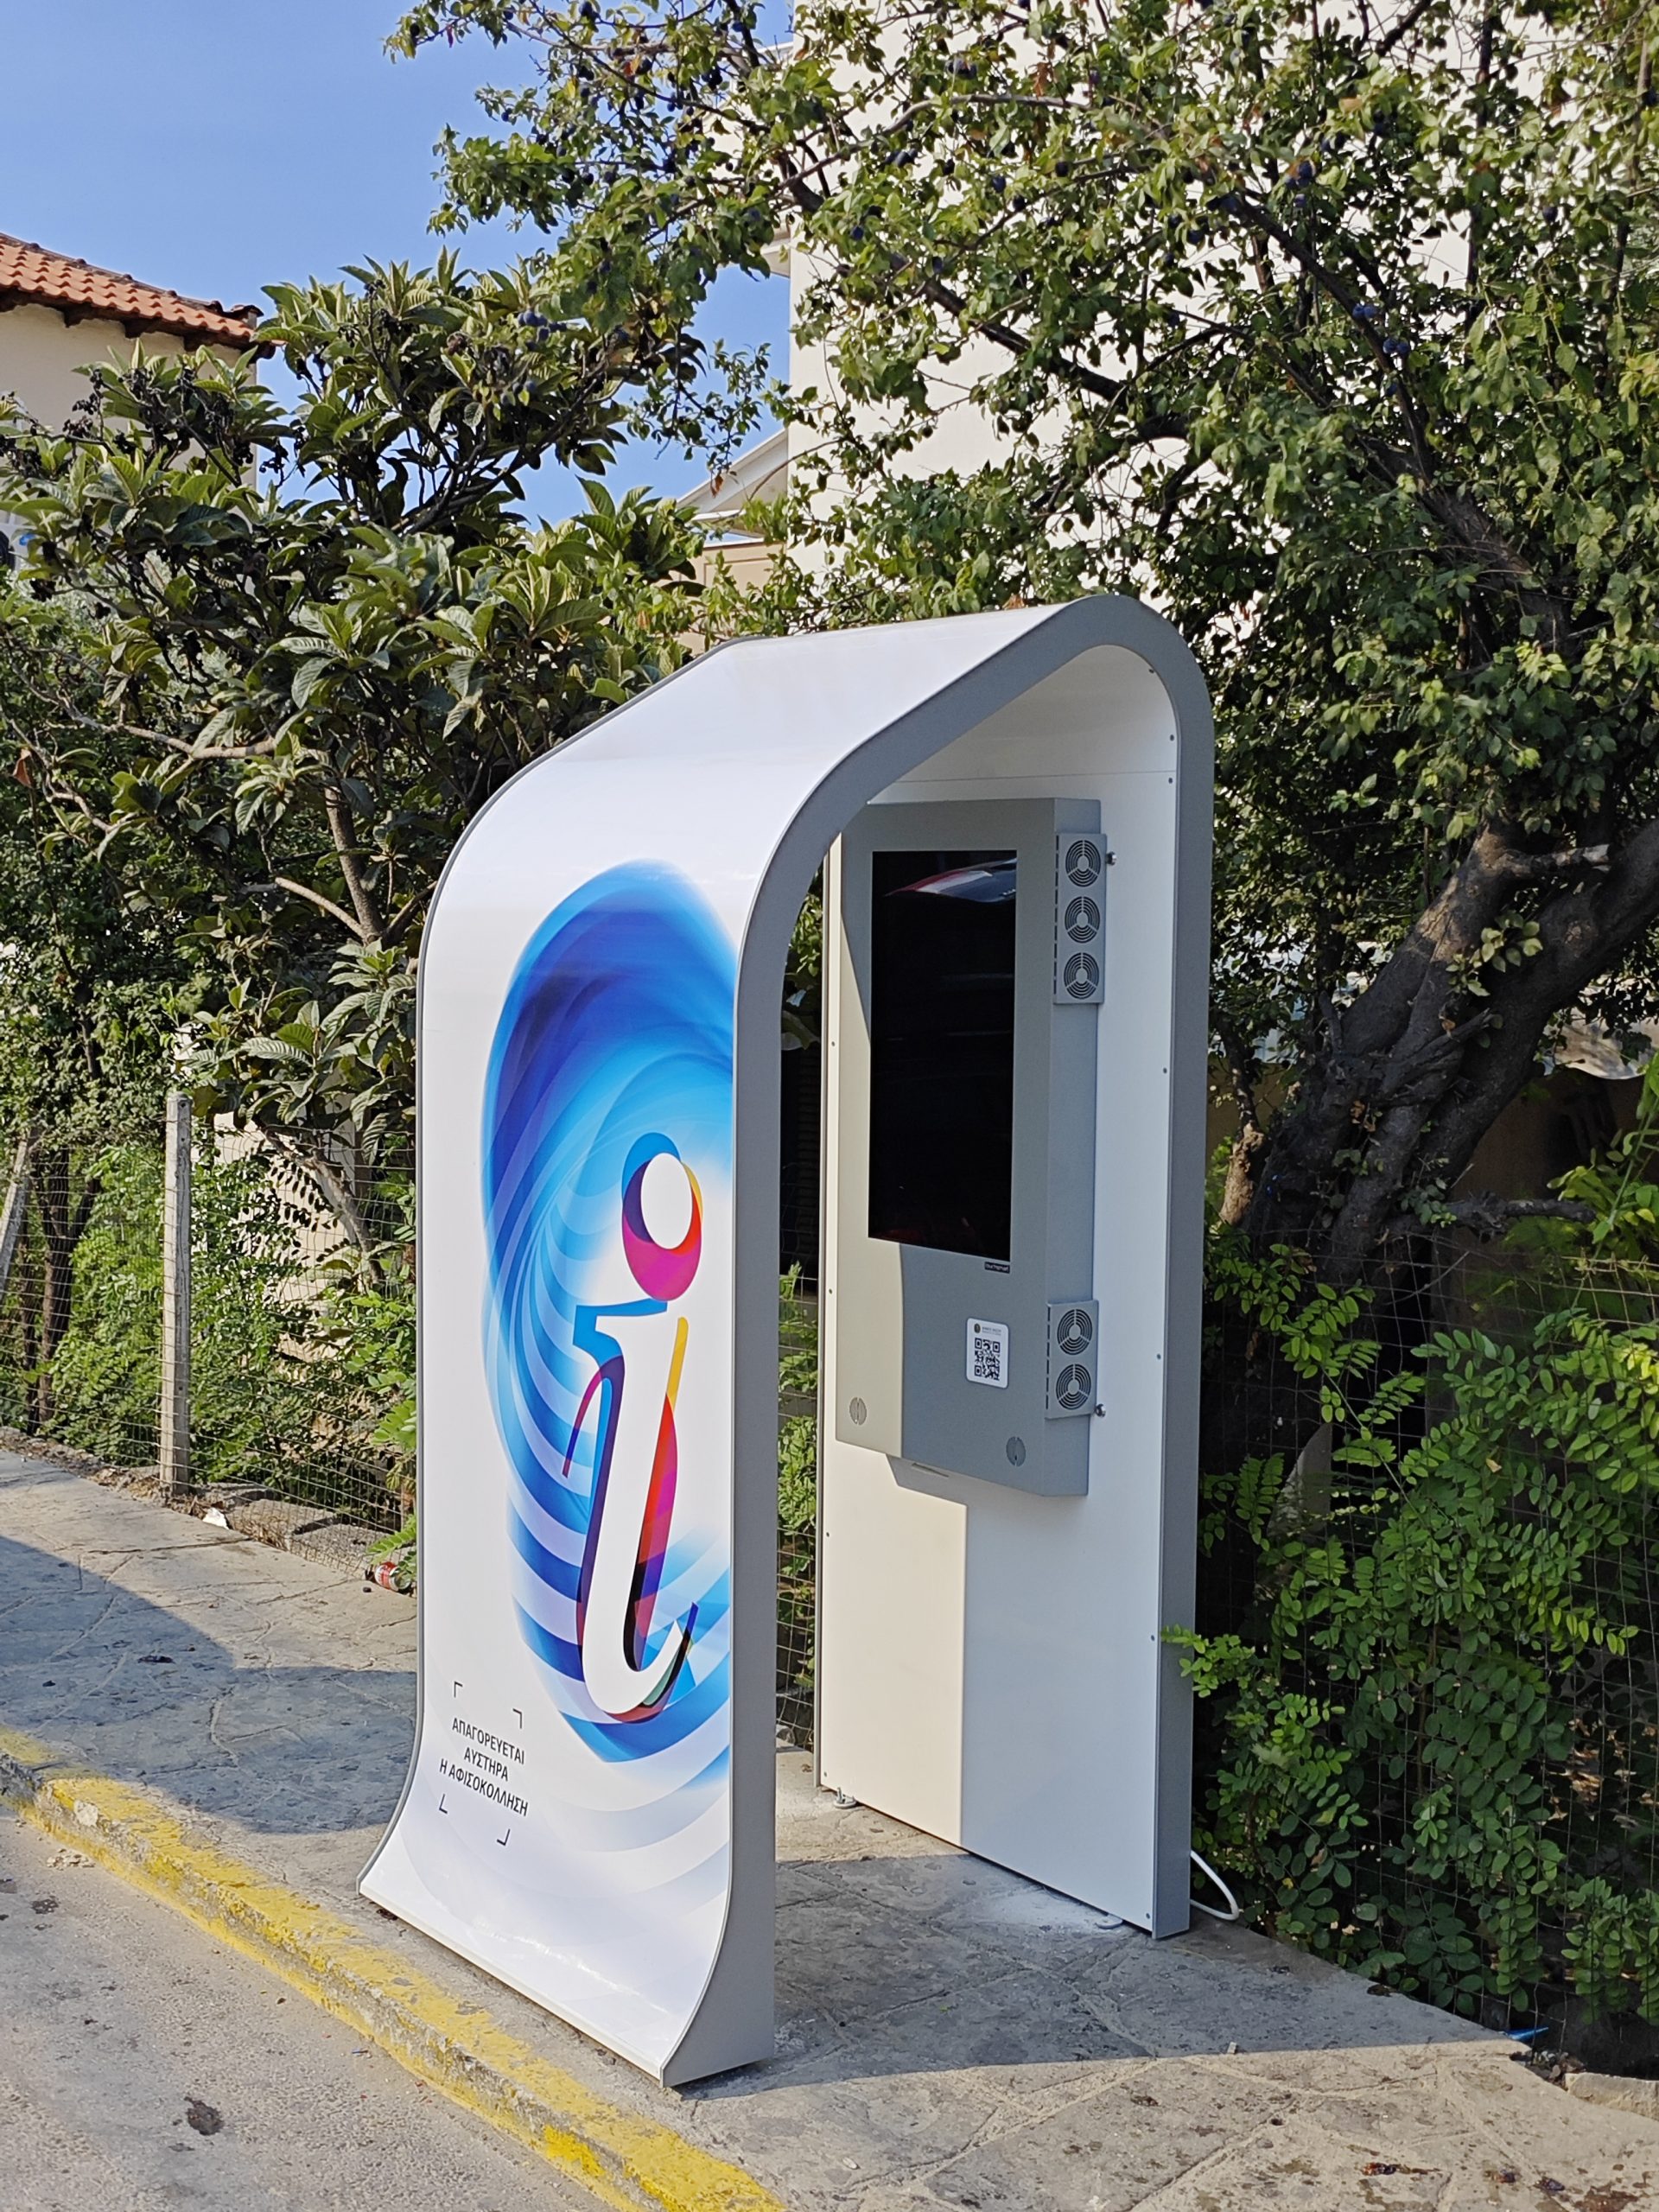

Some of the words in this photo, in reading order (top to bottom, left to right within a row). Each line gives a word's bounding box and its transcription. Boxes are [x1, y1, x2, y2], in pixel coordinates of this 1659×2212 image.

[452, 1717, 524, 1764] ΑΠΑΓΟΡΕΥΕΤΑΙ
[464, 1747, 508, 1781] ΑΥΣΤΗΡΑ
[439, 1758, 448, 1774] Η
[448, 1764, 528, 1816] ΑΦΙΣΟΚΟΛΛΗΣΗ
